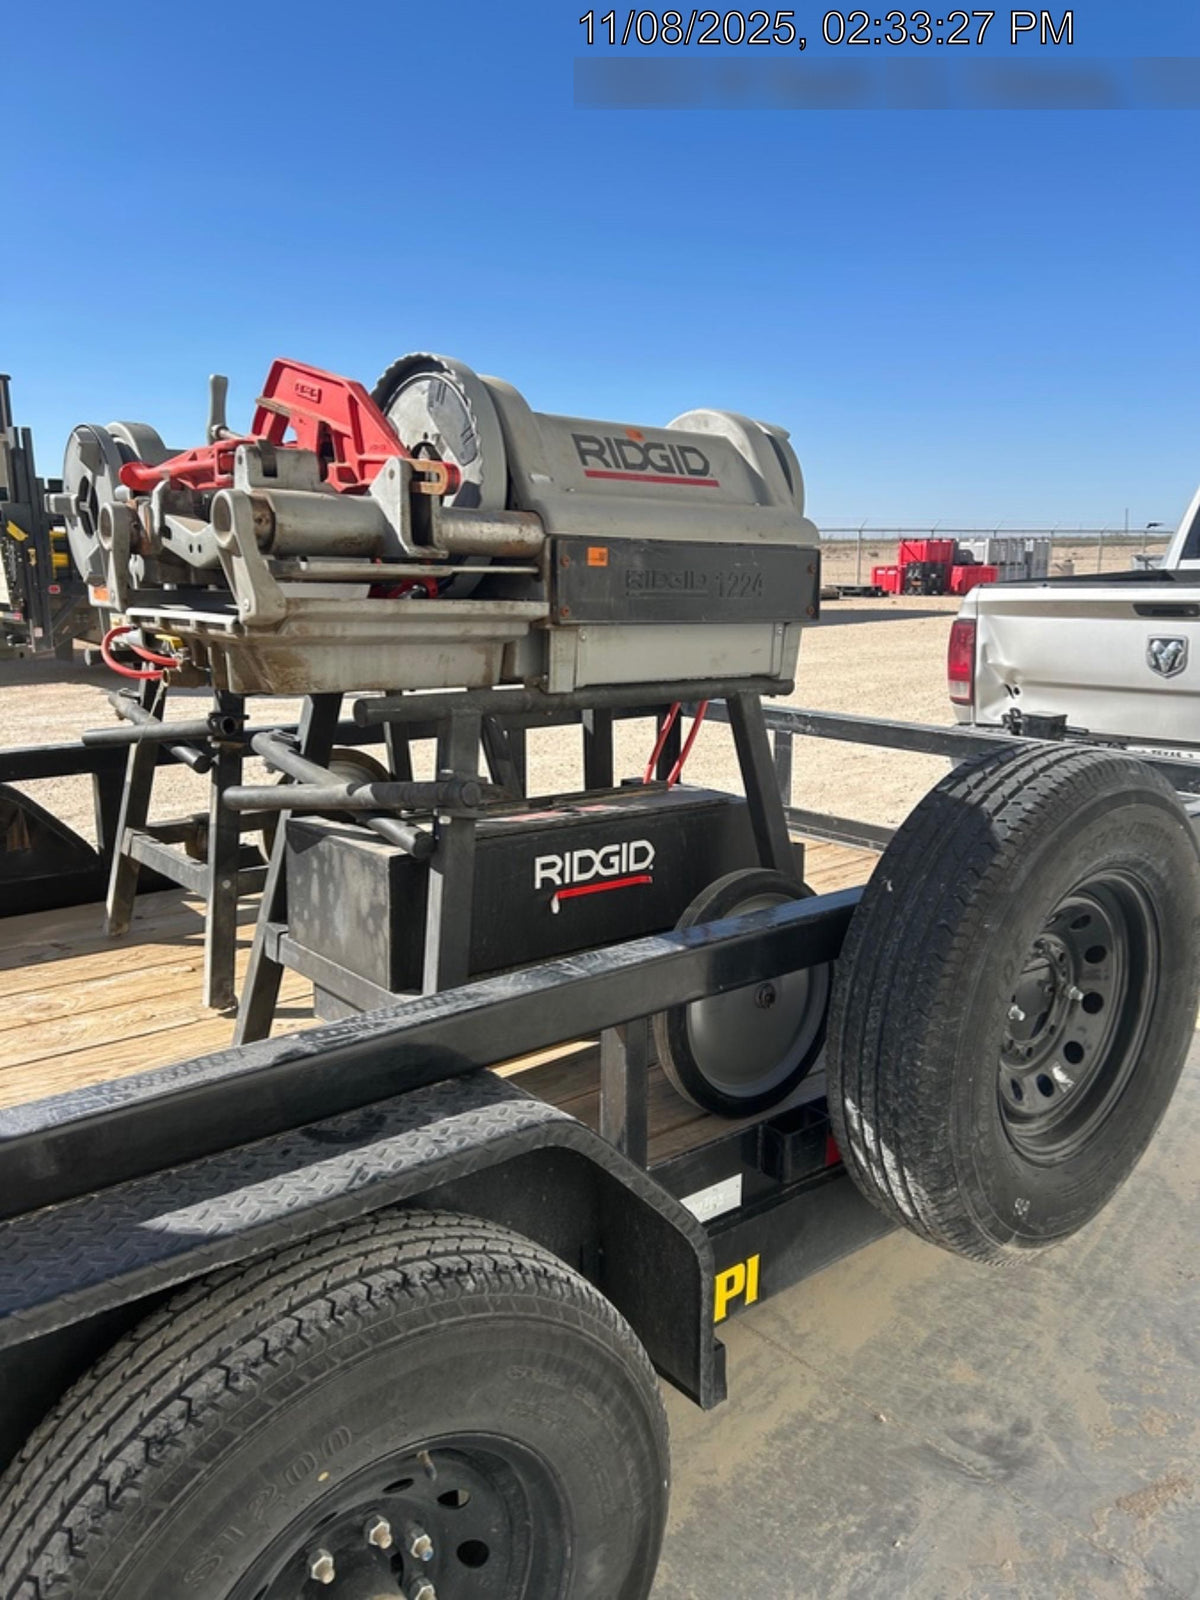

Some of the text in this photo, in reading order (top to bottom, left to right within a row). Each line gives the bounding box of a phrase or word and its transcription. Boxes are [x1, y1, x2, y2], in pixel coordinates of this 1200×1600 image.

[571, 433, 711, 477] RIDGID
[715, 571, 763, 598] 1224
[534, 839, 656, 890] RIDGID
